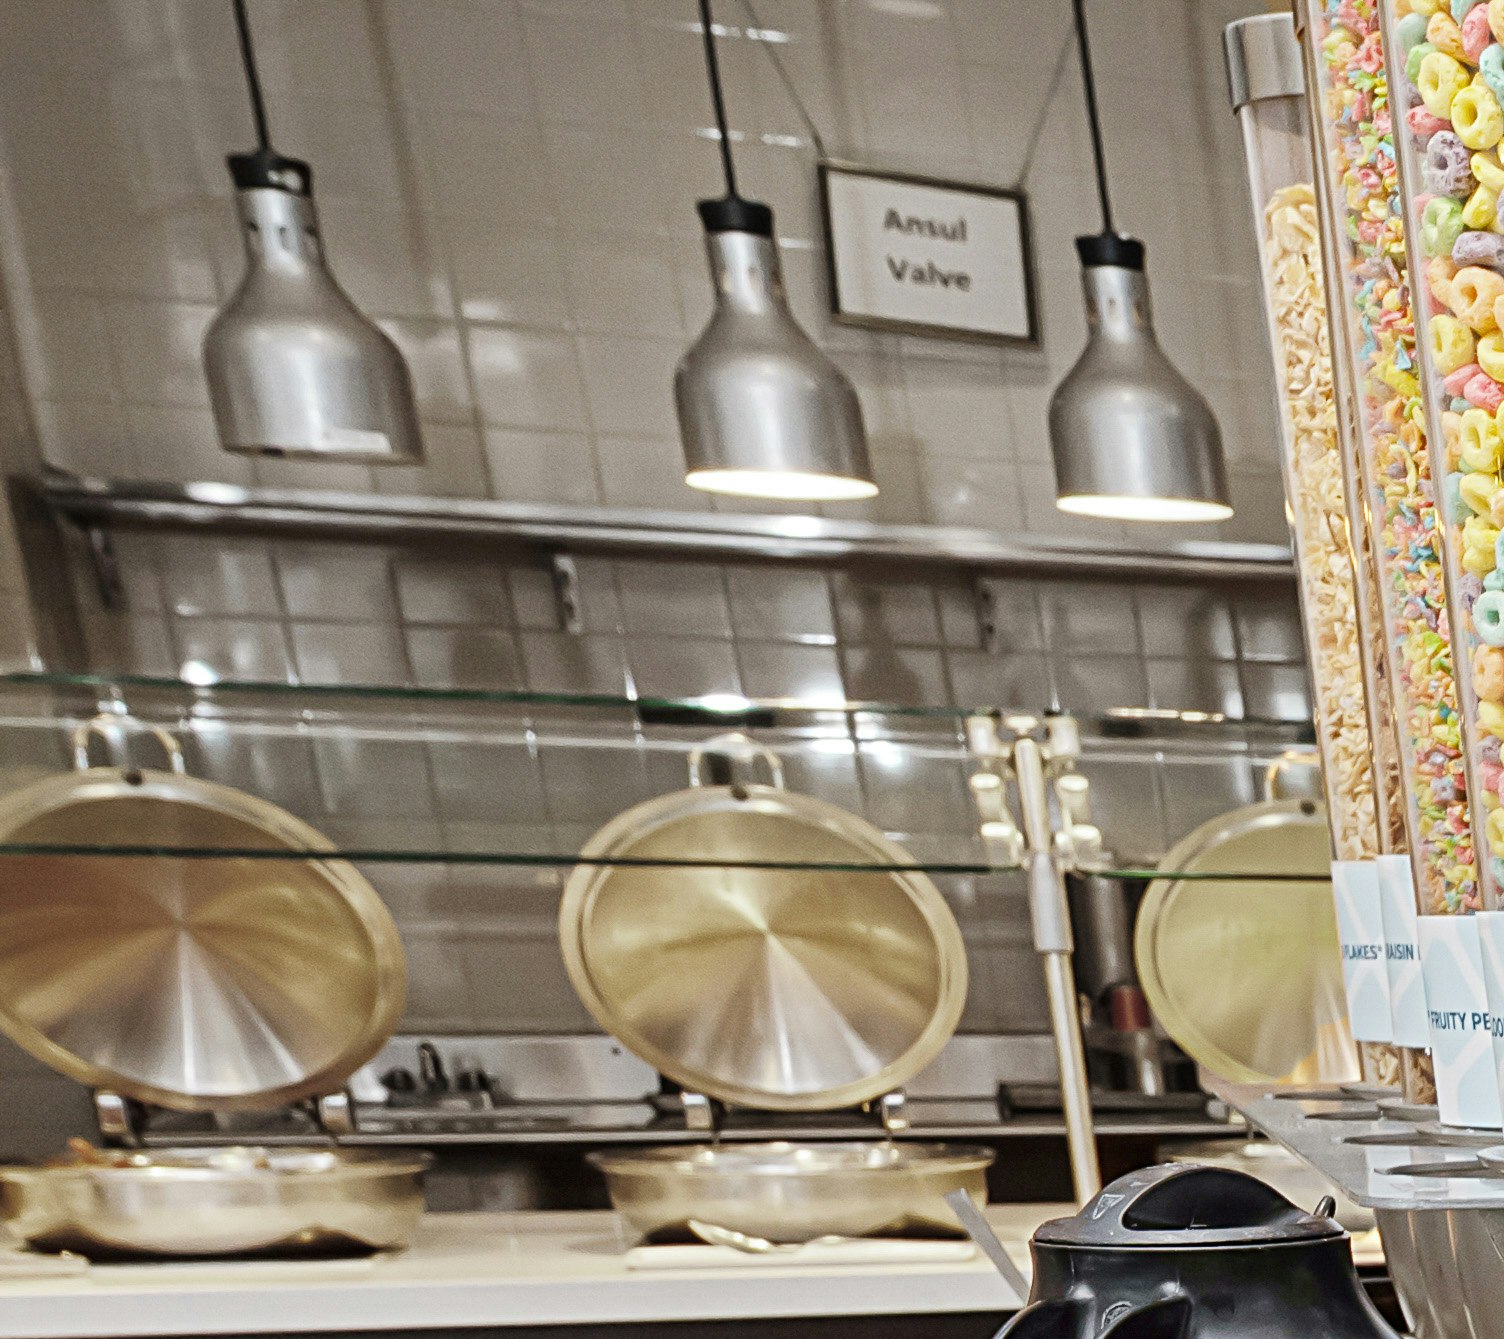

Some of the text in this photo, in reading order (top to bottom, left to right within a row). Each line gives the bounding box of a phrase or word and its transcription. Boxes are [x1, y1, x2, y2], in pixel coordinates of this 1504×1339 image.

[883, 208, 969, 242] Ansul
[886, 256, 972, 291] Valve
[1431, 1011, 1491, 1031] FRUITY PE
